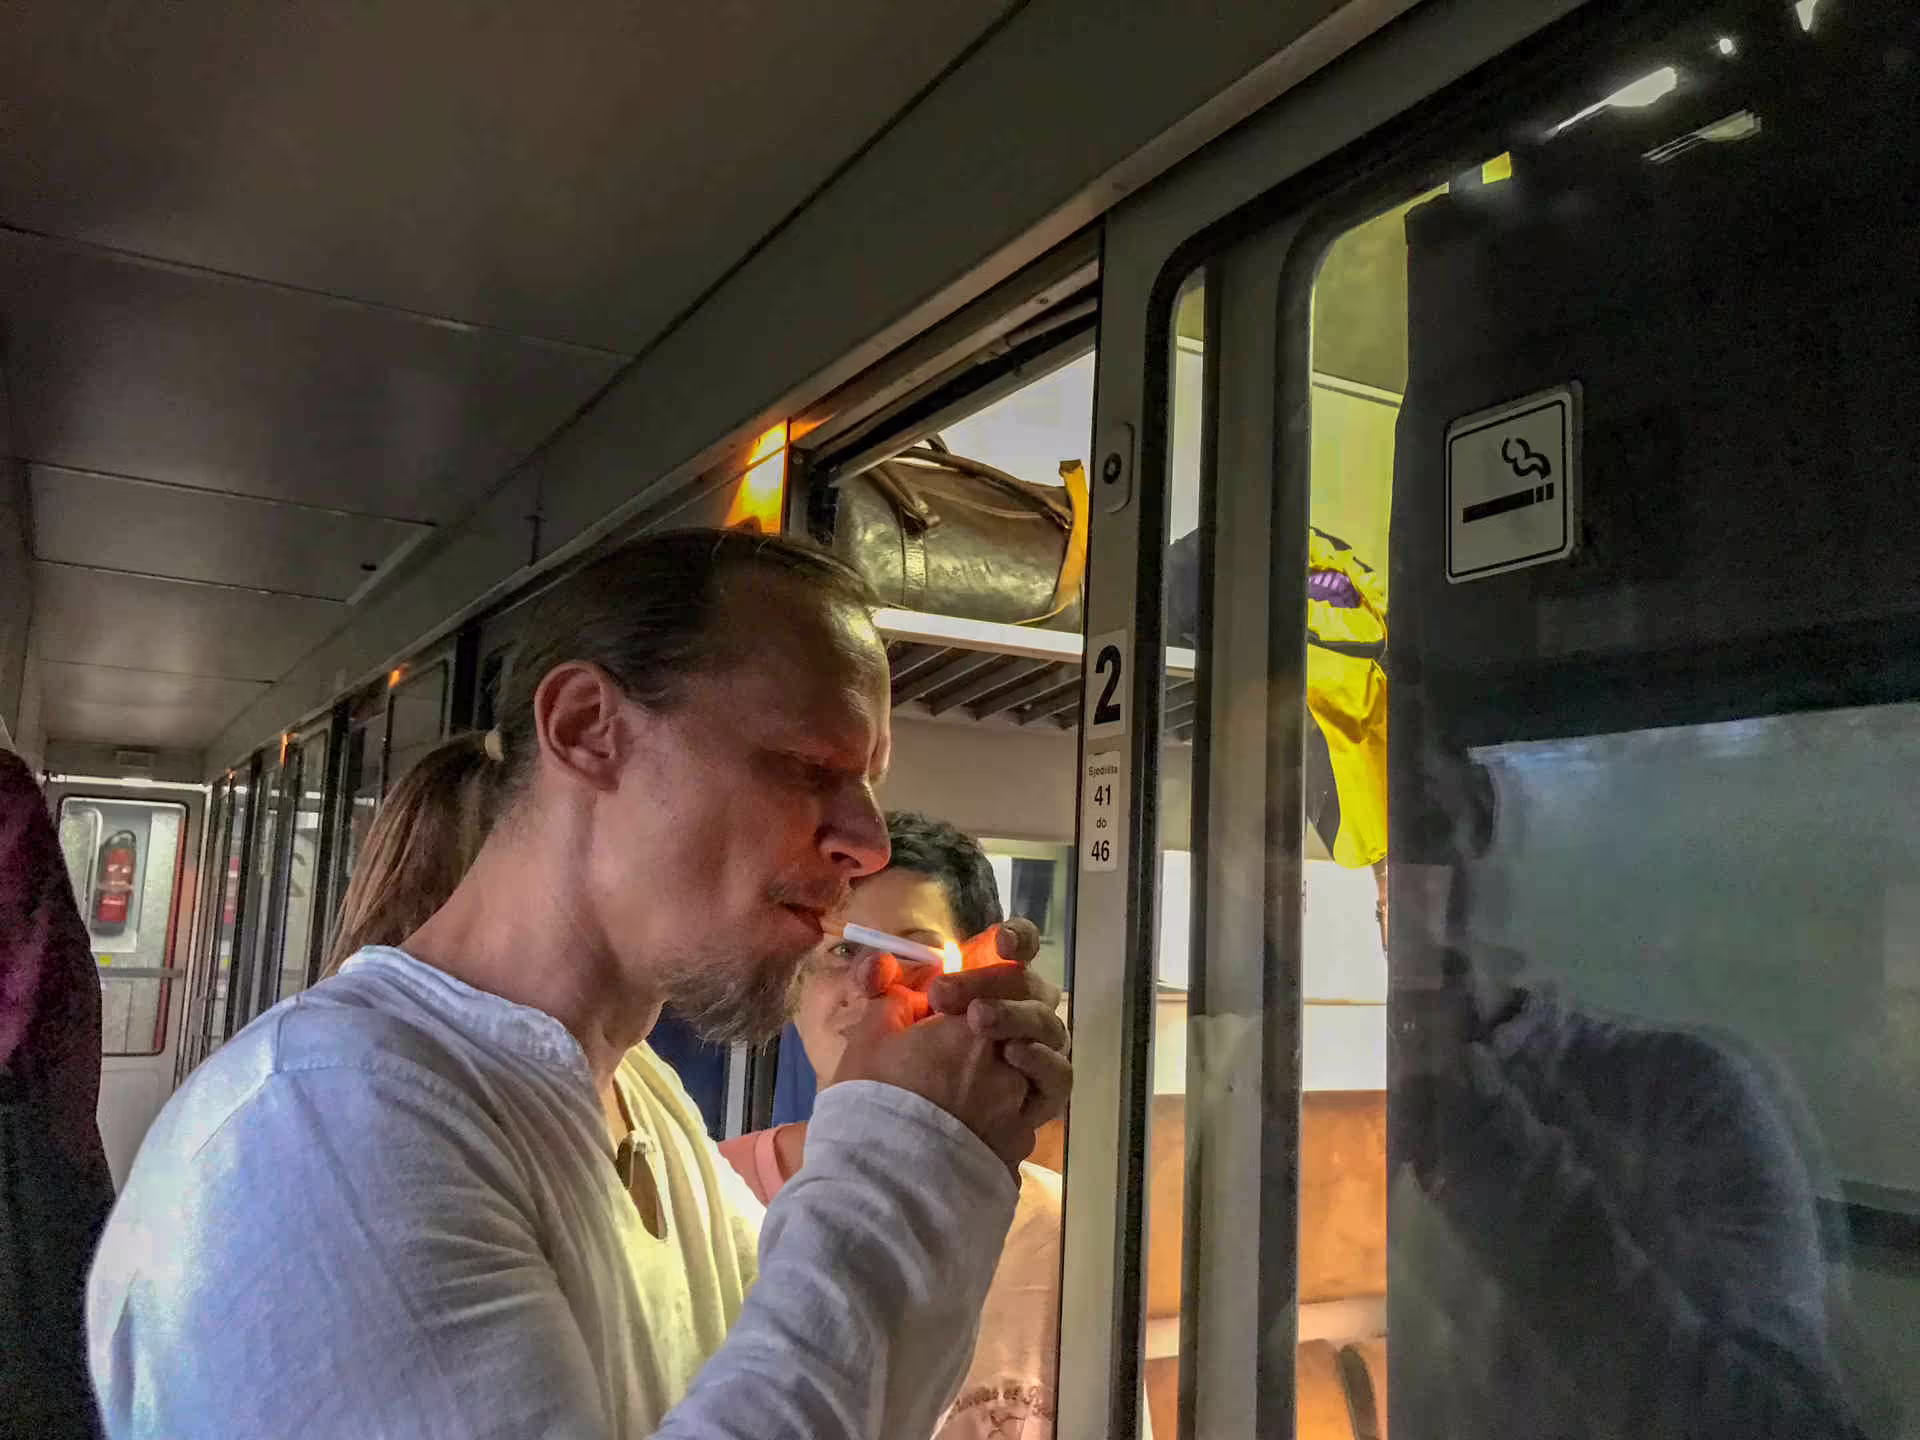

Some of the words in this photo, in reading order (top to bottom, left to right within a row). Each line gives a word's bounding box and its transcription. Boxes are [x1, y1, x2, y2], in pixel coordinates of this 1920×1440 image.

[1093, 644, 1121, 725] 2
[1094, 784, 1111, 806] 41
[1096, 816, 1108, 829] do
[1091, 839, 1110, 862] 46
